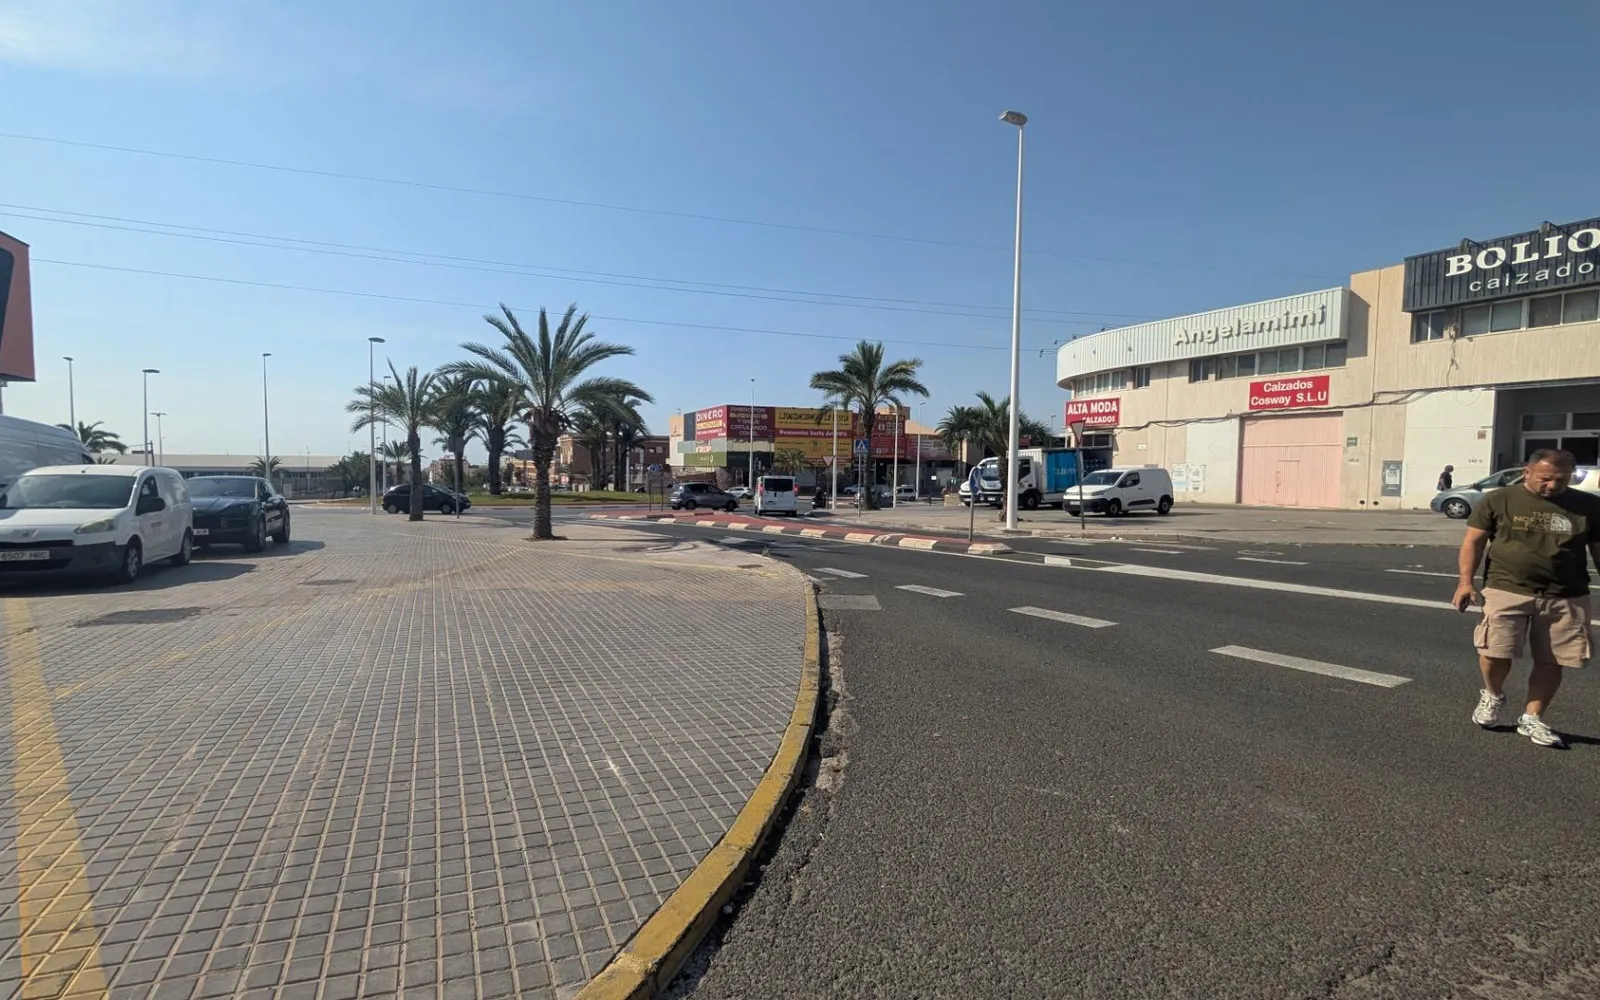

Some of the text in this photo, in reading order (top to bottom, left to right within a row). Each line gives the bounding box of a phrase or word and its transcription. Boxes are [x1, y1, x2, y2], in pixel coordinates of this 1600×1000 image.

[1445, 228, 1600, 277] BOLIO
[1469, 262, 1594, 292] calzado
[1174, 304, 1327, 346] Angelamimi
[1263, 380, 1314, 393] Calzados
[1067, 400, 1118, 415] ALTA MODA
[1251, 395, 1291, 406] Cosway
[696, 409, 723, 422] DINERO
